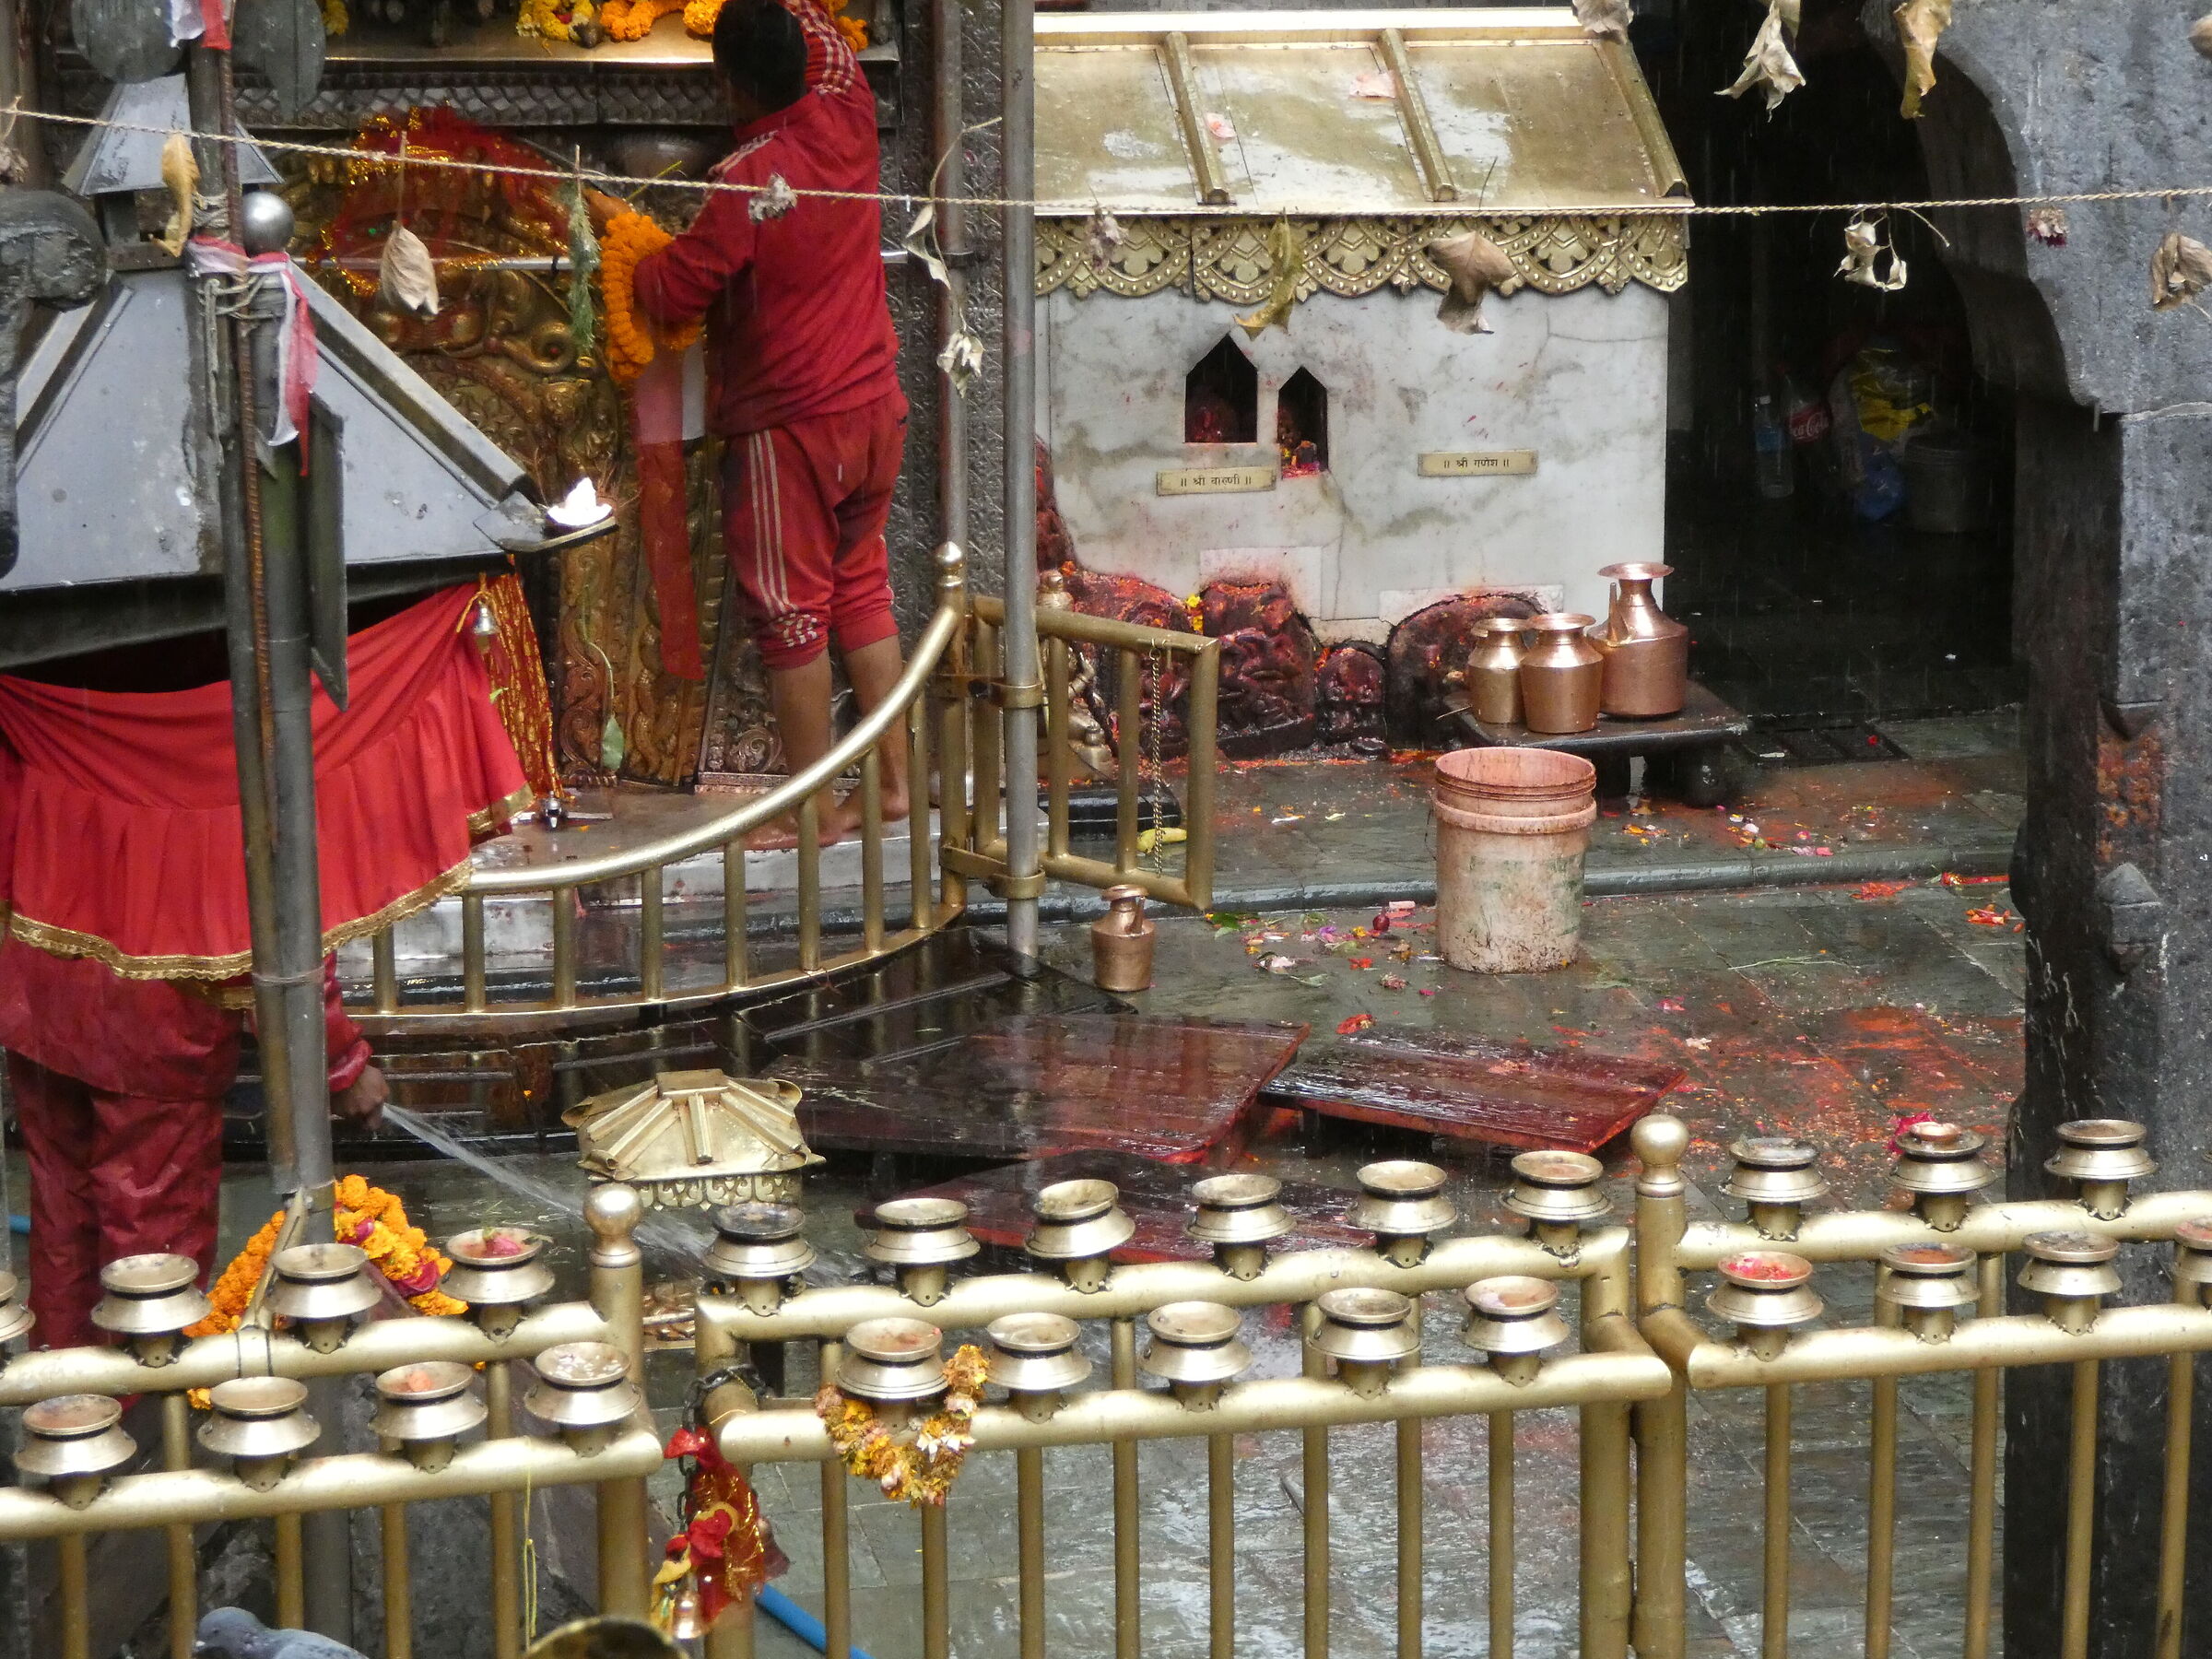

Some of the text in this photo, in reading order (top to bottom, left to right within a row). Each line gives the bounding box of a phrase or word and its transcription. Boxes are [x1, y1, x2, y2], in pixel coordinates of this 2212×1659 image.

[1455, 457, 1468, 468] श्री
[1474, 457, 1498, 468] गणेश
[1193, 475, 1206, 487] श्री
